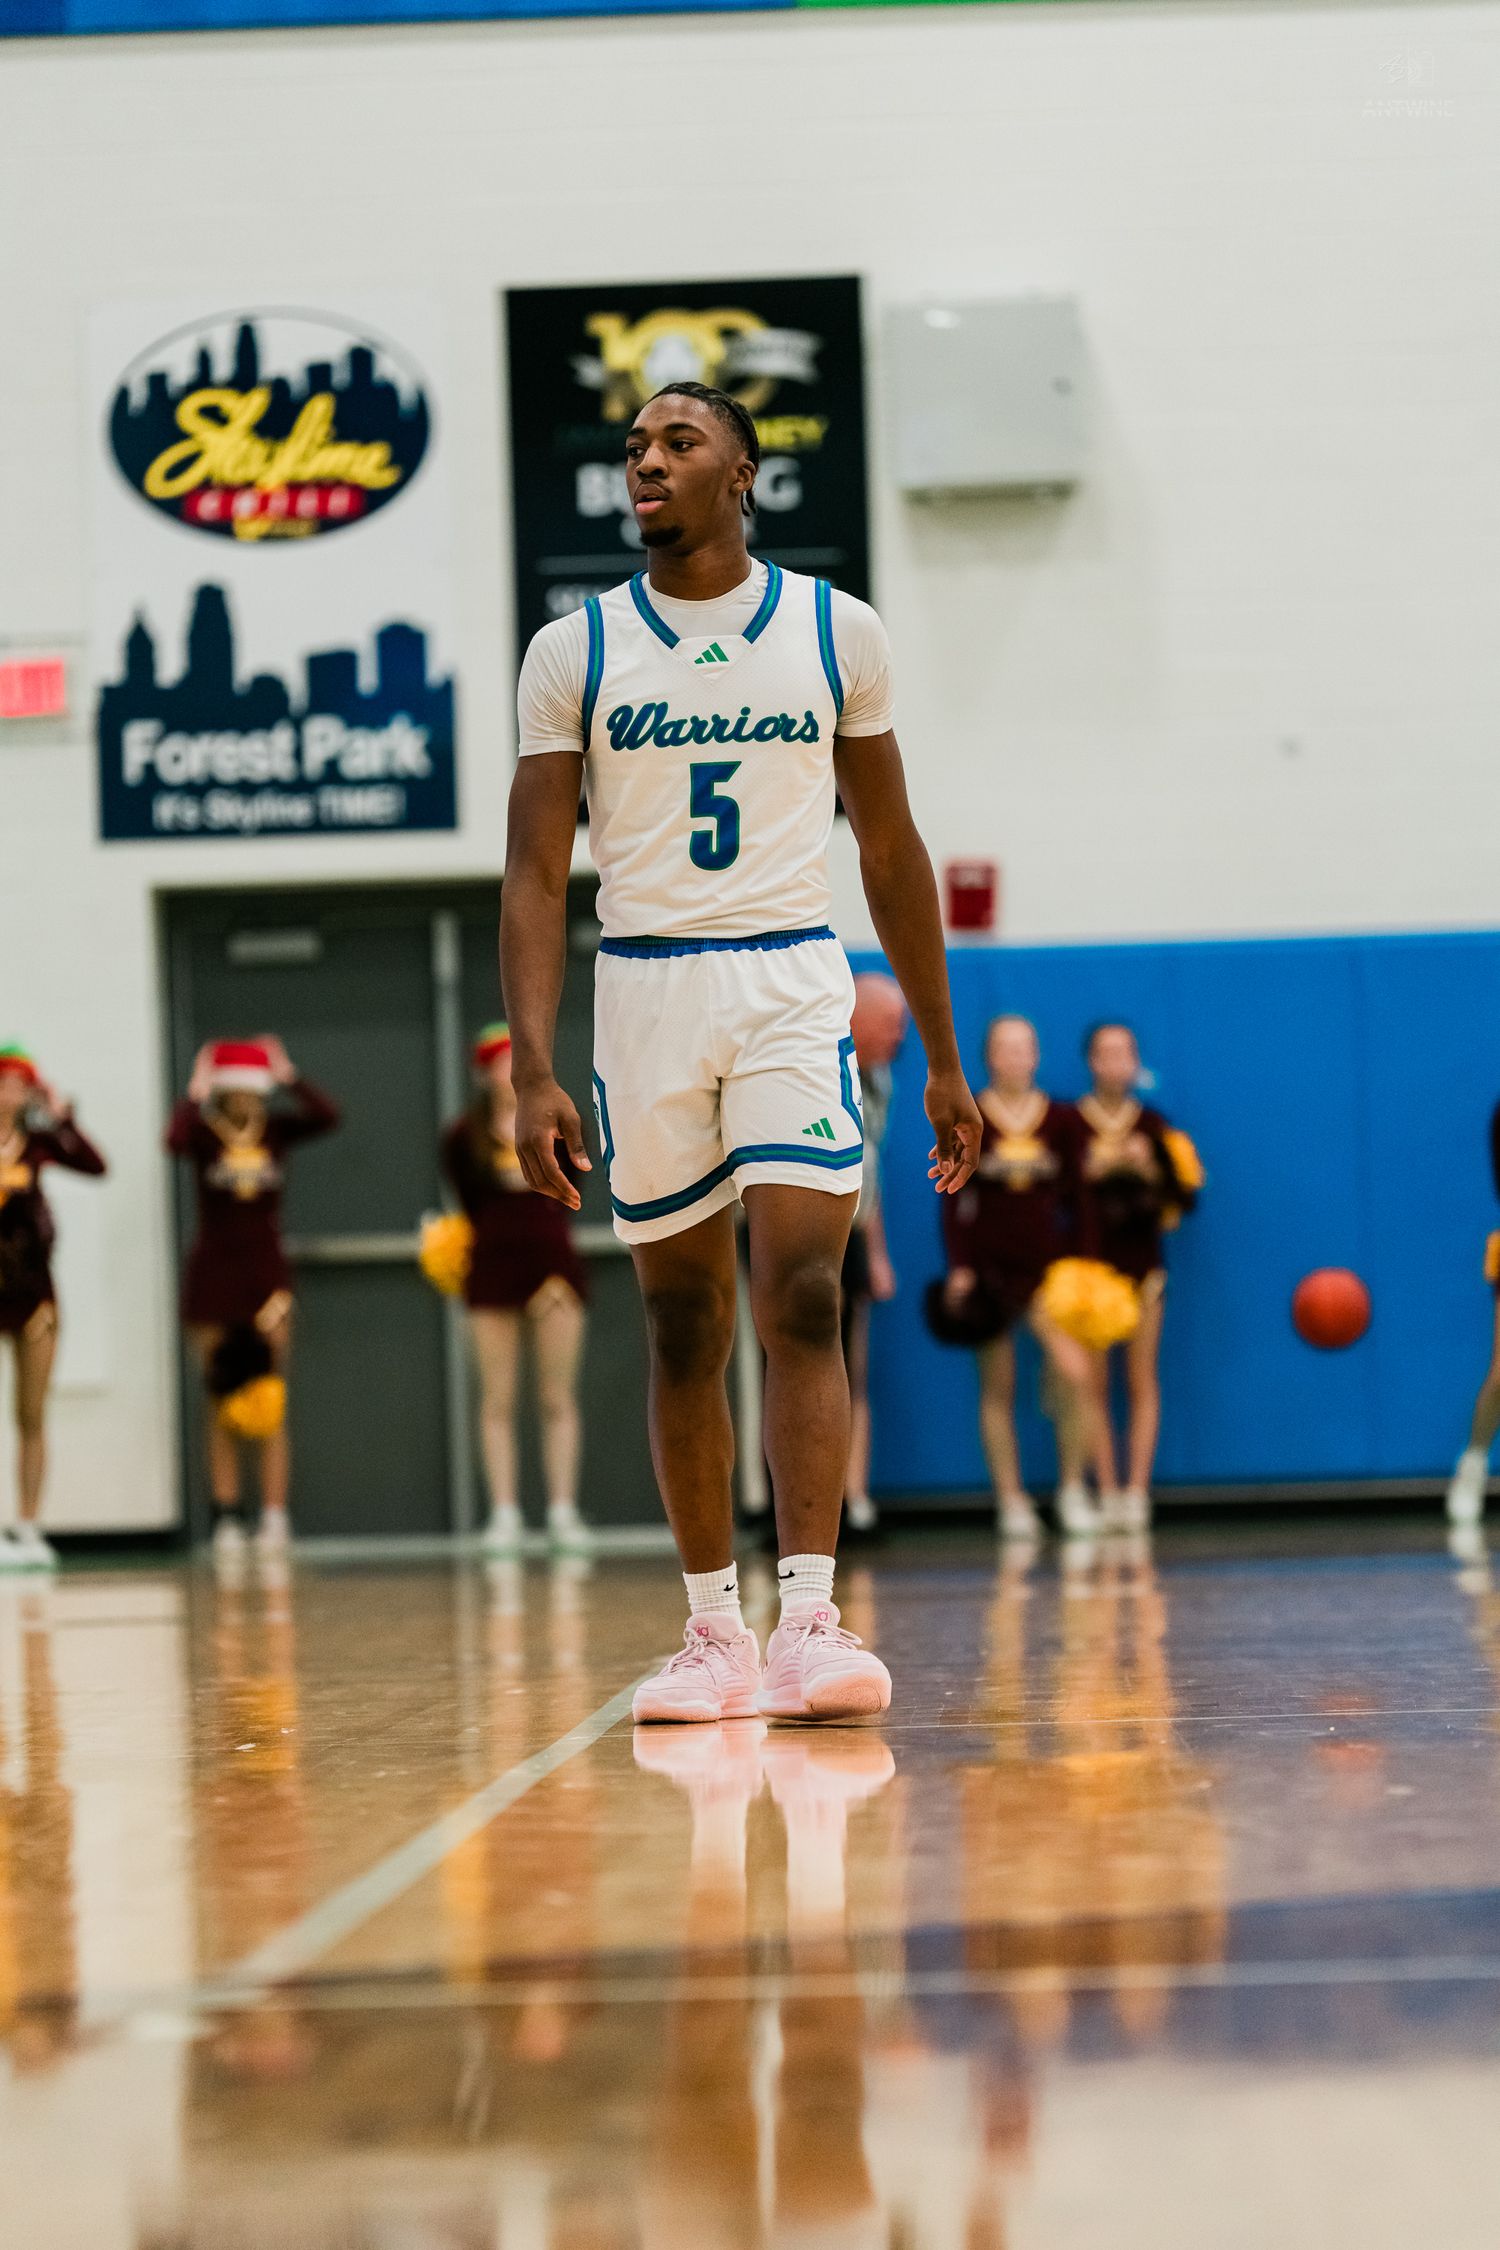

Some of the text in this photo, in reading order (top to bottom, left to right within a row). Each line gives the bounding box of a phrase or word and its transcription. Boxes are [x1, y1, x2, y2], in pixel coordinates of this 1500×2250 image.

[121, 711, 432, 787] Forest Park
[606, 701, 820, 751] Warriors
[689, 761, 742, 871] 5
